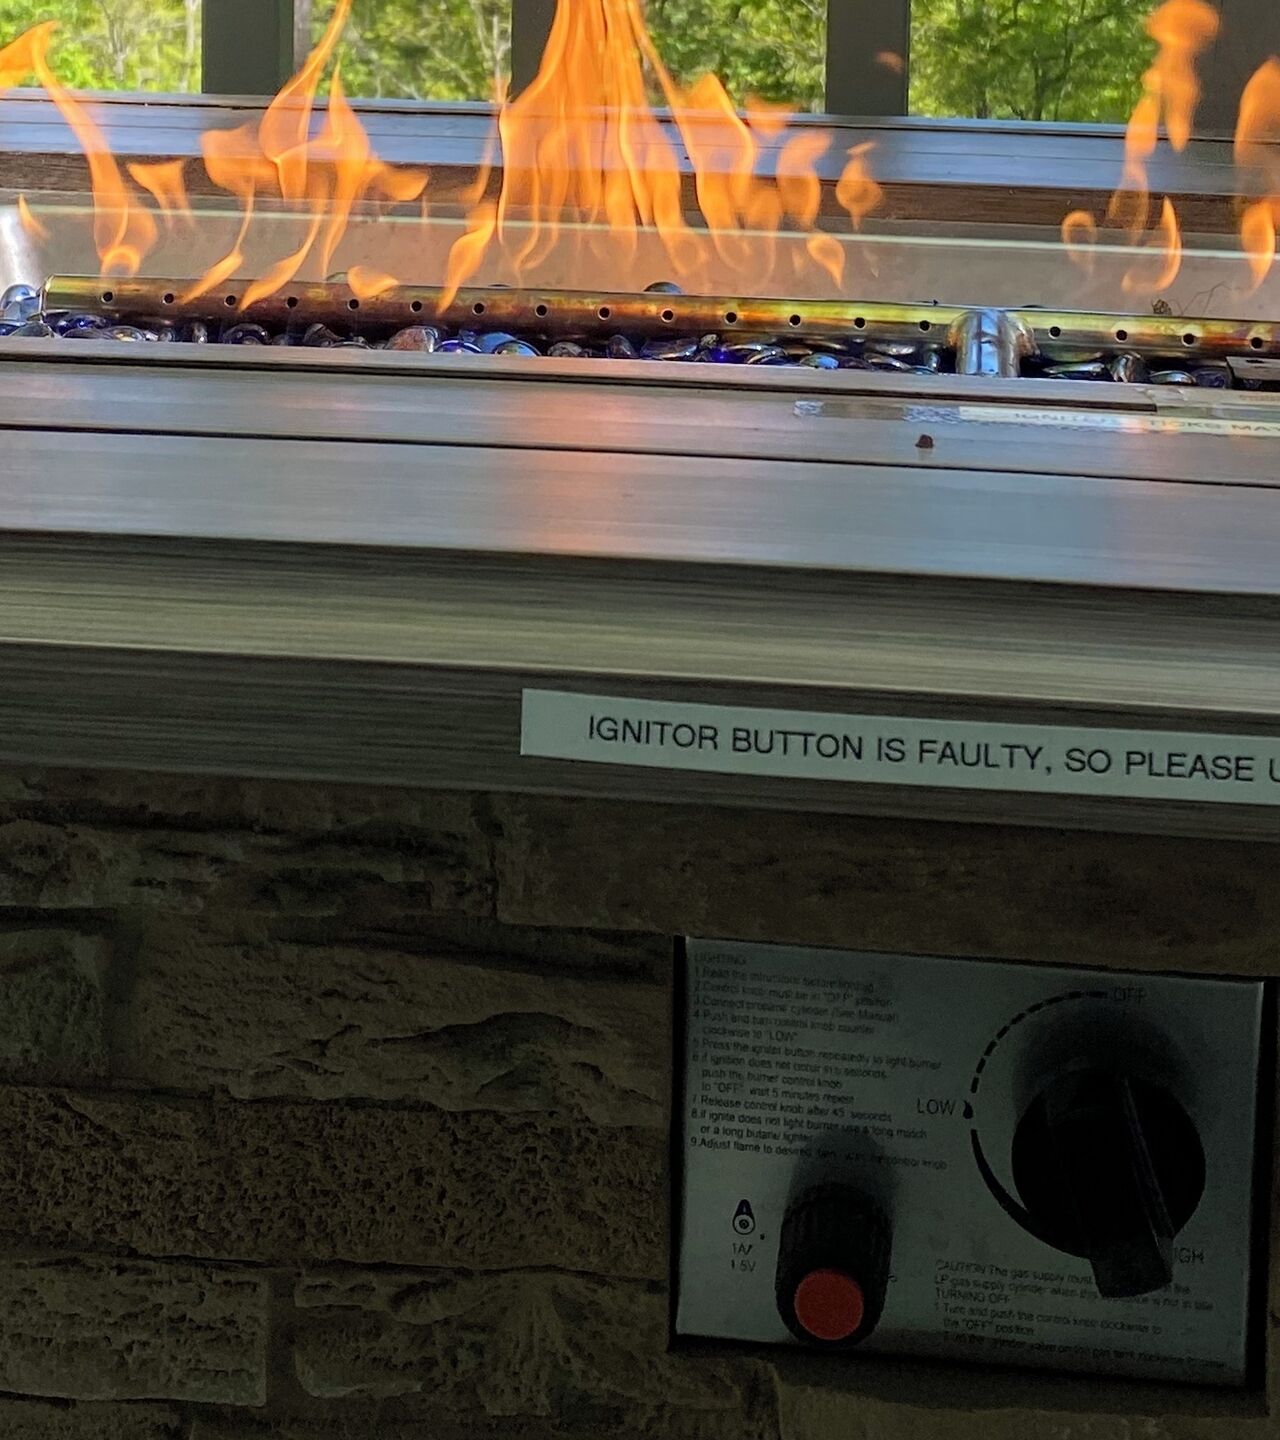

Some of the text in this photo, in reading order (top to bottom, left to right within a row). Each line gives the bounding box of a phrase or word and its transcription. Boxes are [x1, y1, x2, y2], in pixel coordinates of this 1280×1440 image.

[589, 715, 718, 750] IGNITOR
[732, 727, 863, 760] BUTTON
[877, 737, 906, 762] IS
[919, 739, 1052, 775] FAULTY,
[1064, 747, 1112, 773] SO
[1126, 751, 1255, 782] PLEASE
[917, 1097, 957, 1117] LOW
